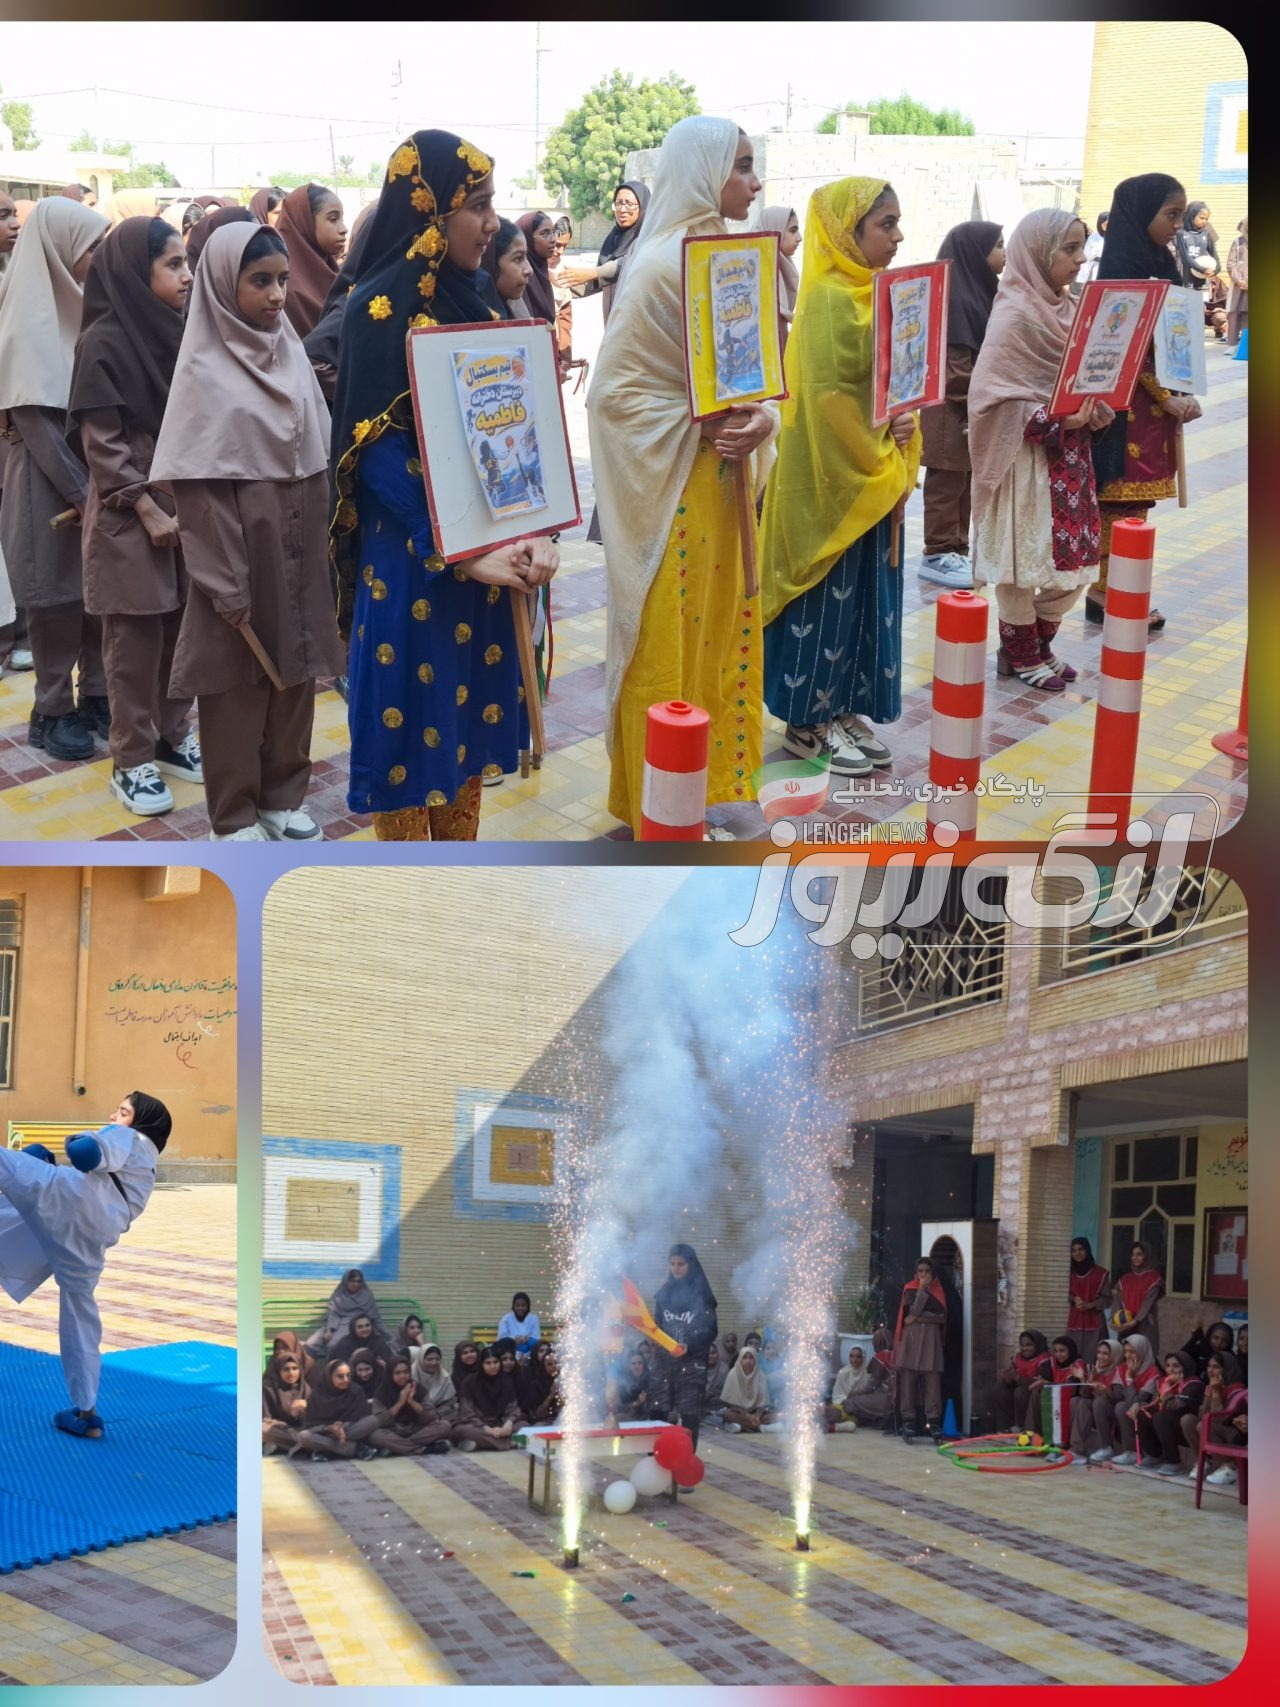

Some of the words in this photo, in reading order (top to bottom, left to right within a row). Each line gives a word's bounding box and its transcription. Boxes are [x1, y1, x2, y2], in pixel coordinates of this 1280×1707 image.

[465, 364, 499, 388] بسکتبال
[500, 360, 511, 377] تیم
[476, 401, 526, 436] فاطمیه
